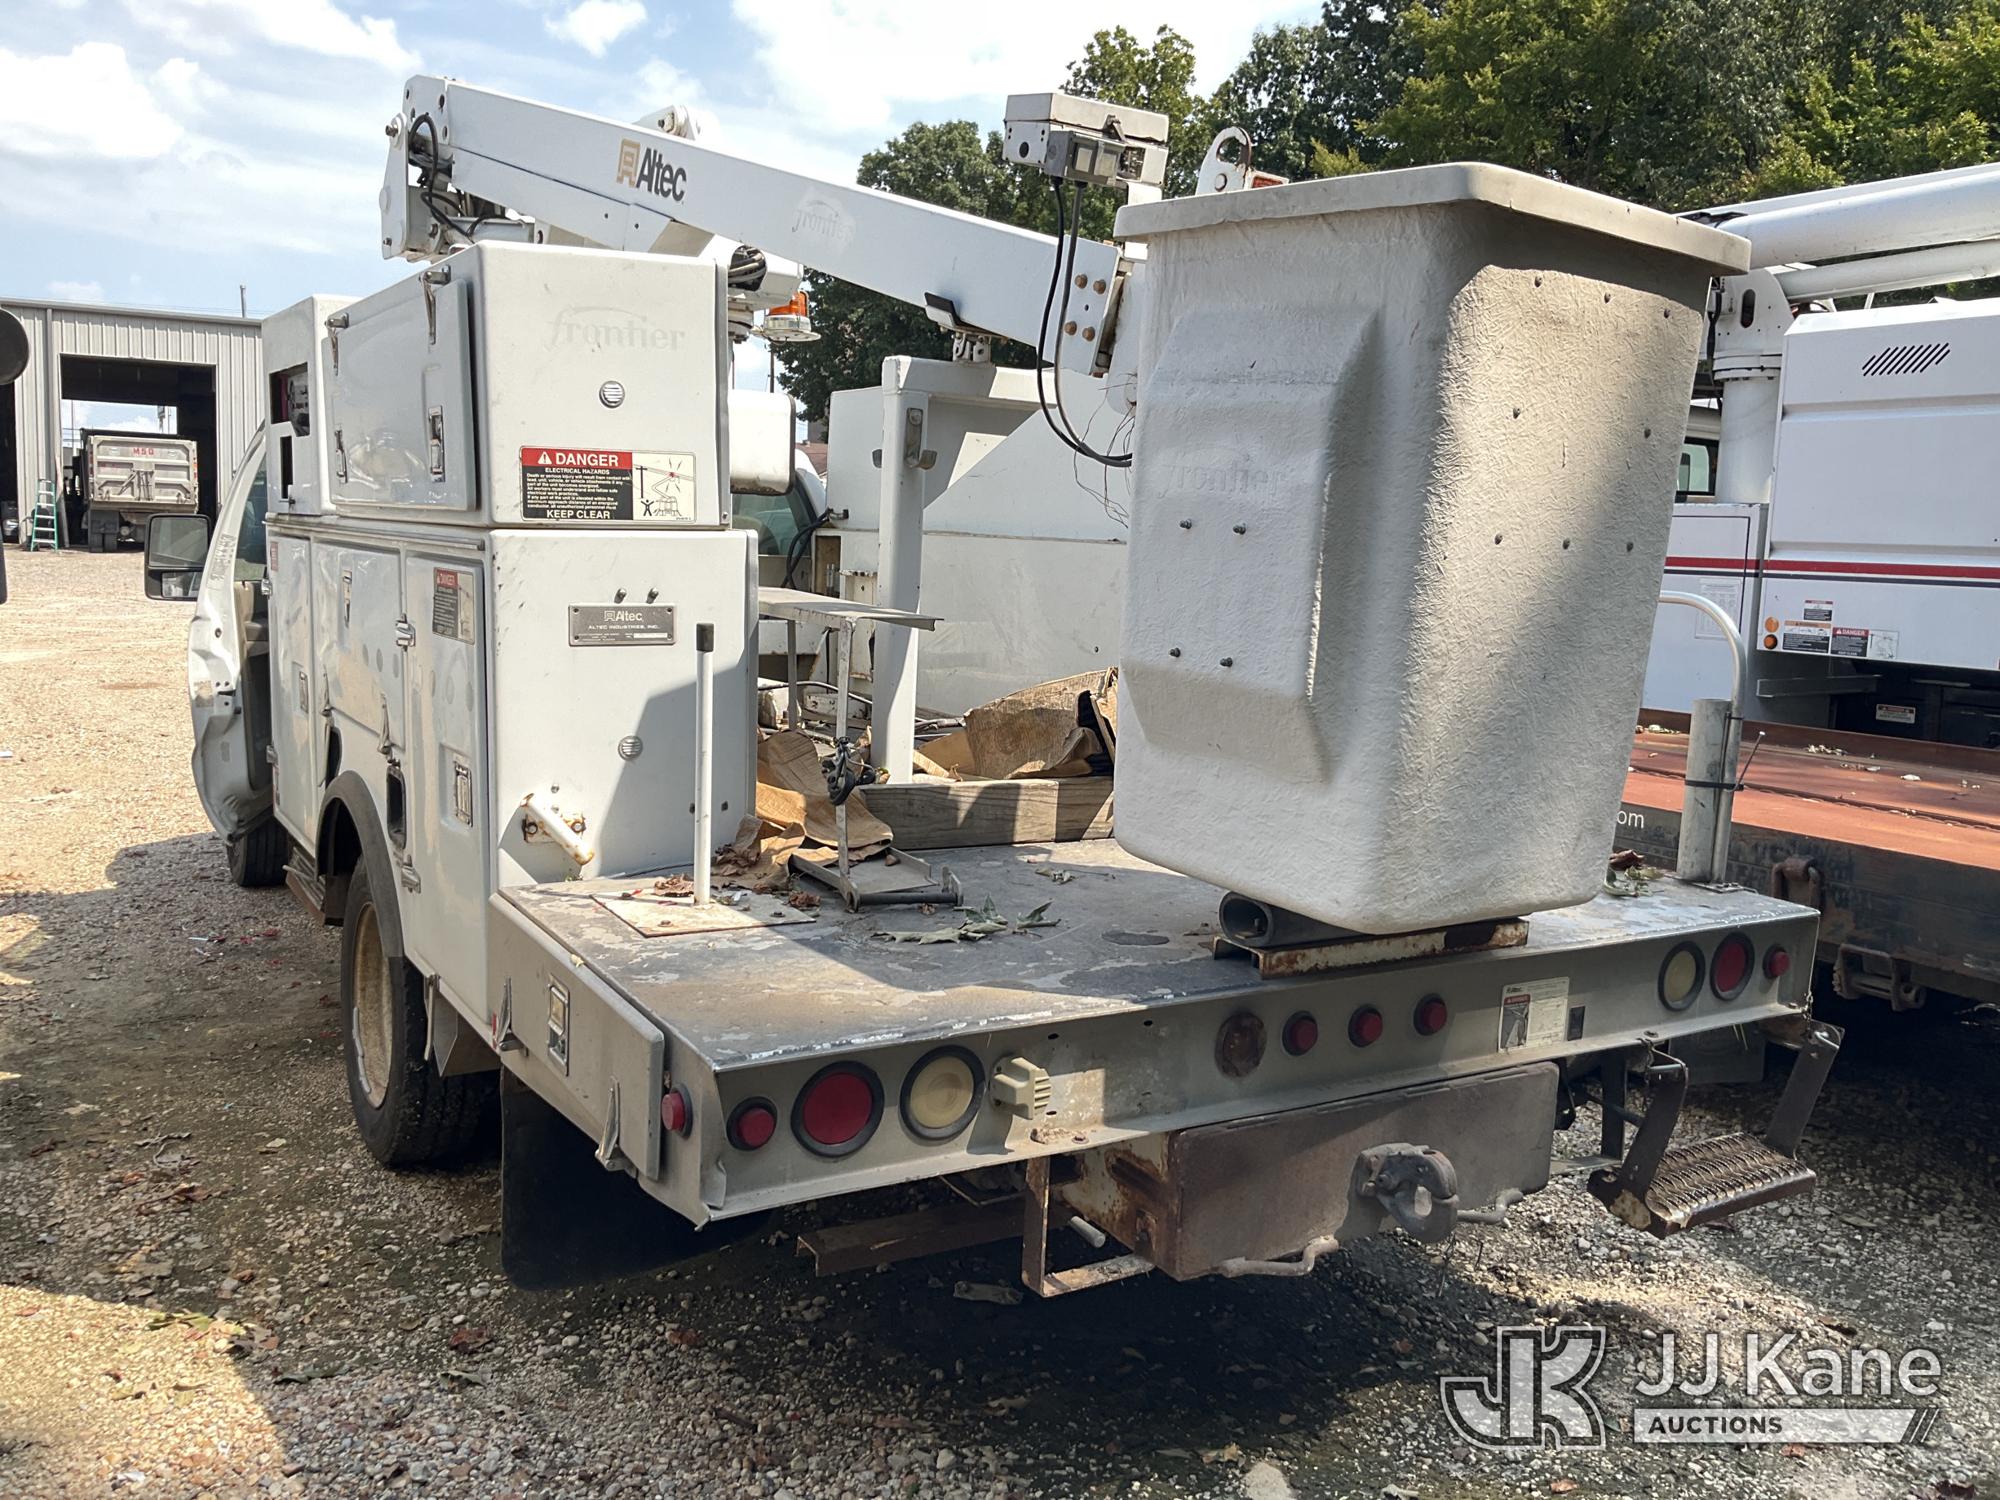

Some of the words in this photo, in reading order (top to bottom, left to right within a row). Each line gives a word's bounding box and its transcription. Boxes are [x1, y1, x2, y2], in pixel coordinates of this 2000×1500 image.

[636, 147, 686, 202] Altec
[542, 306, 686, 352] frontier
[555, 452, 619, 467] DANGER
[546, 509, 574, 519] KEEP
[576, 510, 610, 519] CLEAR
[615, 610, 643, 622] Altec
